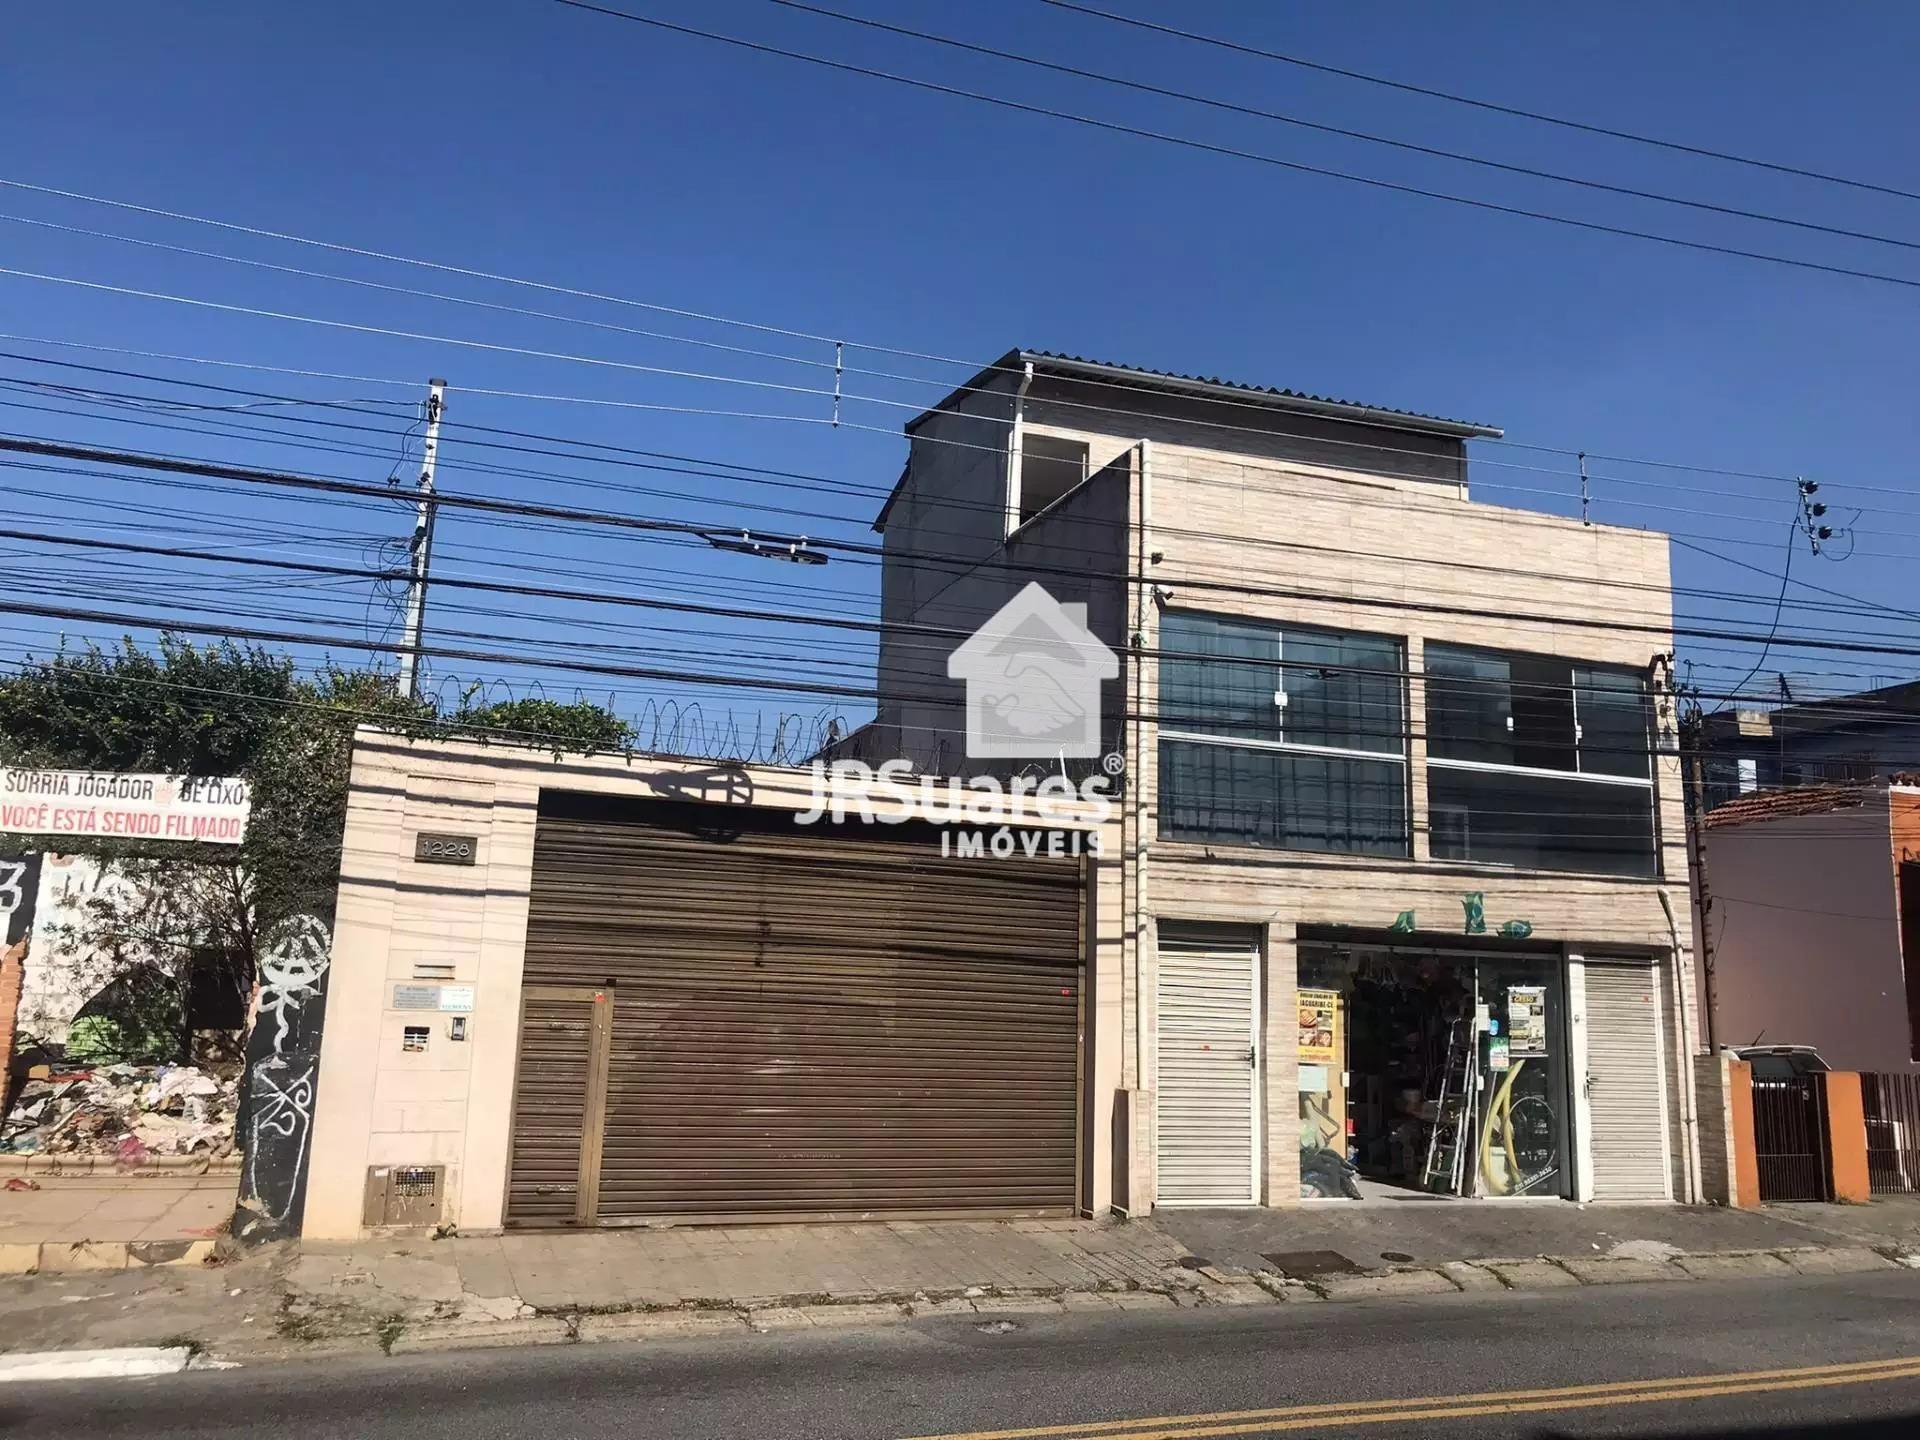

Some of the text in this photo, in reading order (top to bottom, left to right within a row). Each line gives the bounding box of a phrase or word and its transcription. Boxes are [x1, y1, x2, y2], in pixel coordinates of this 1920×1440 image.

[5, 771, 69, 796] SORRIA
[75, 776, 154, 800] JOGADOR
[208, 782, 244, 805] LIXO
[1, 803, 241, 838] VOCÊ ESTÁ SENDO FILMADO
[423, 840, 470, 857] 1228
